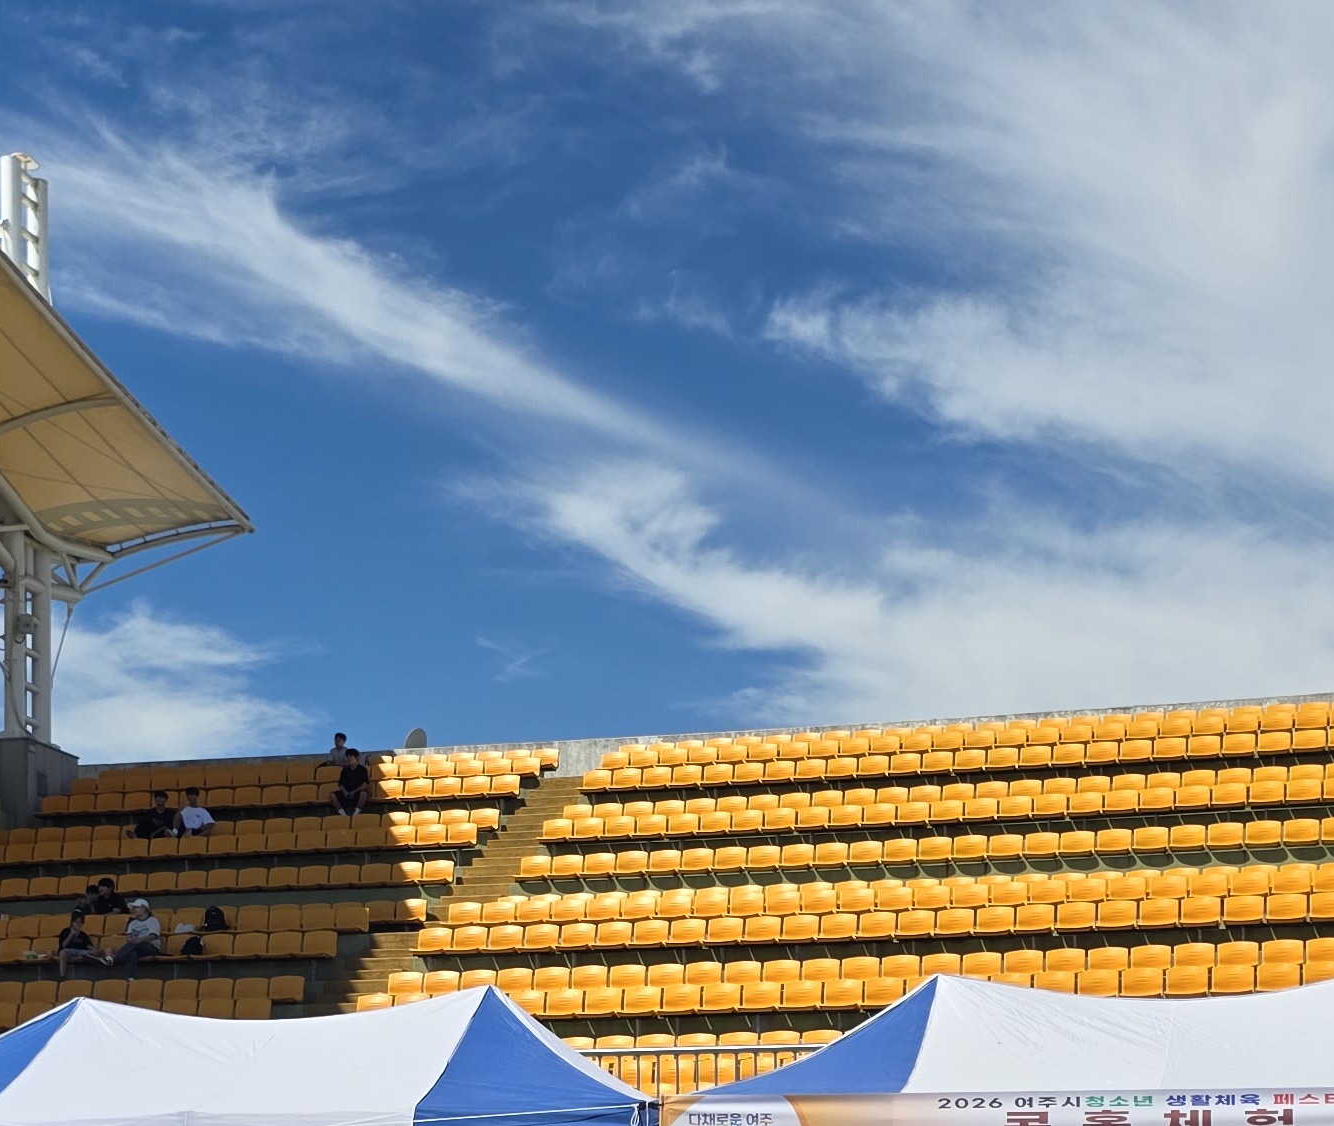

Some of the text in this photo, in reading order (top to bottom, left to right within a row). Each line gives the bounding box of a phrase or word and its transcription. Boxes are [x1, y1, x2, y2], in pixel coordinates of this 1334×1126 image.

[938, 1097, 1003, 1109] 2026
[1166, 1093, 1261, 1106] 생활체육
[688, 1113, 774, 1126] 다채로운 여주
